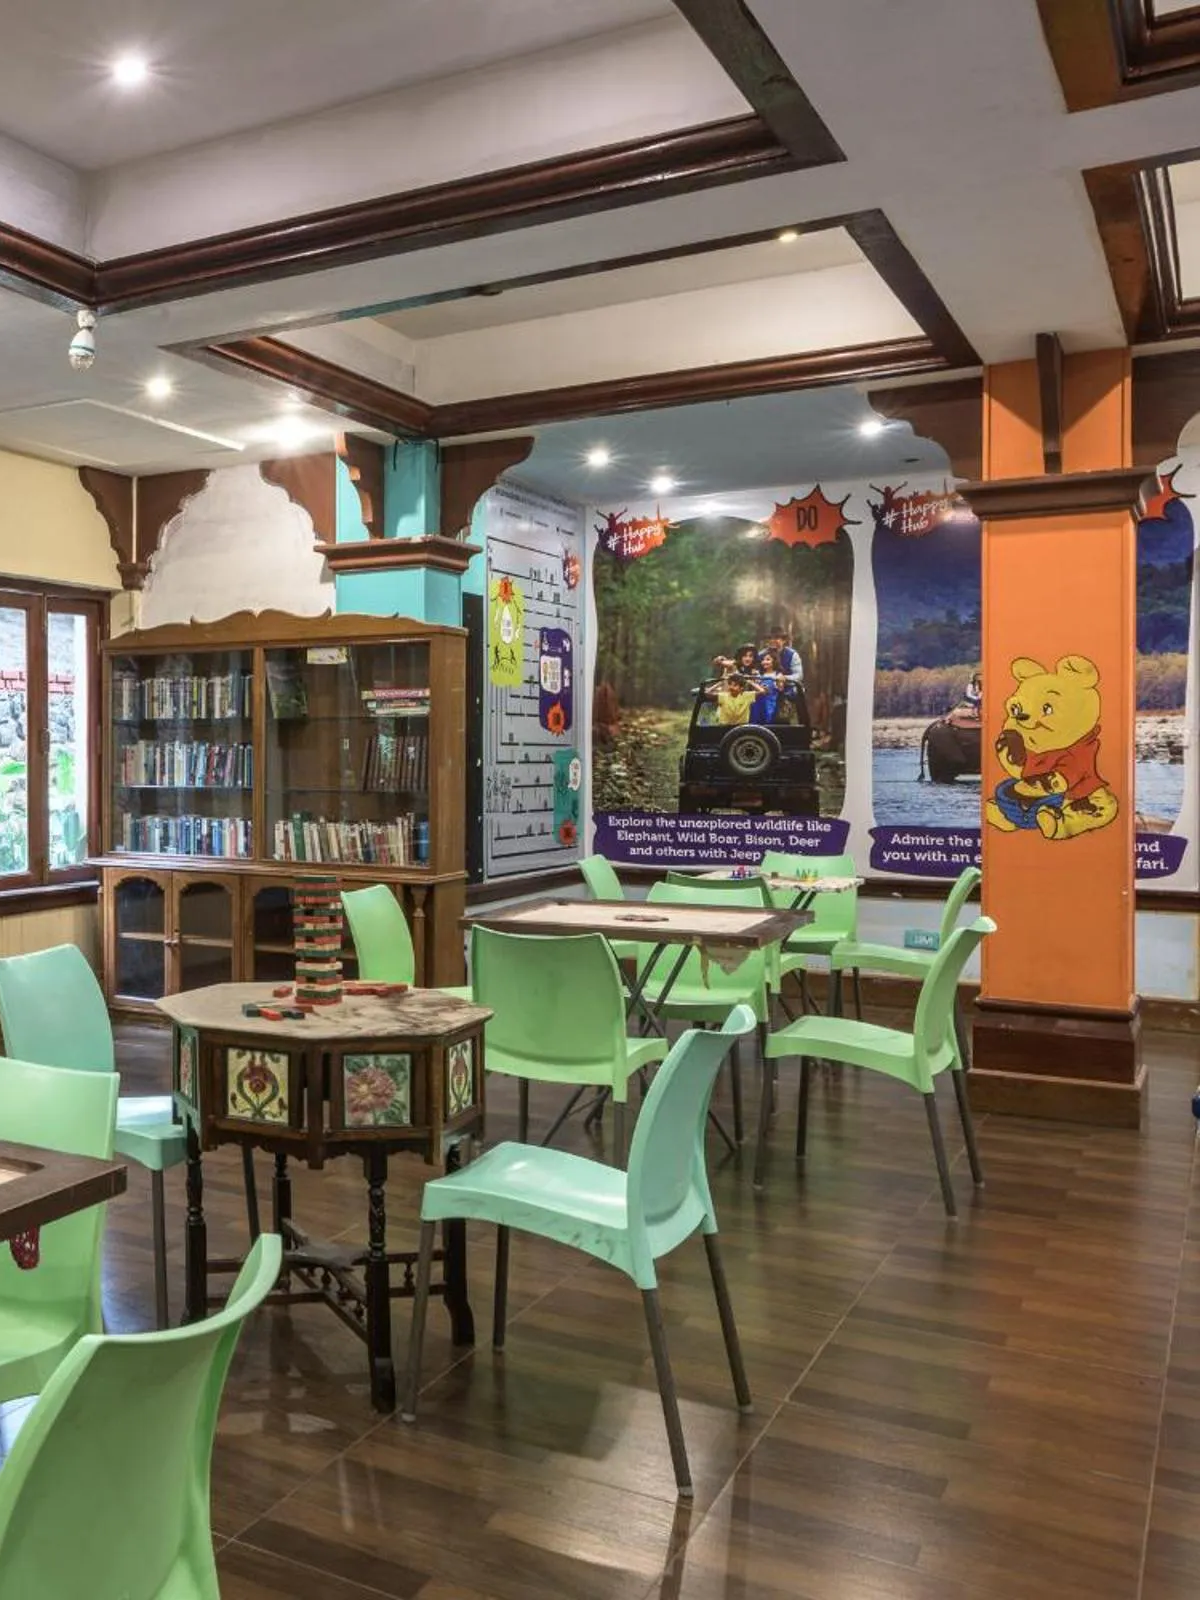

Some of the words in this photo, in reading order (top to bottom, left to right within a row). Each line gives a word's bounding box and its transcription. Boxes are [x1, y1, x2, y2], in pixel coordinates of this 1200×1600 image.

[902, 499, 952, 518] Happy
[796, 507, 818, 532] DO
[902, 517, 929, 533] Hub
[623, 524, 662, 542] Happy
[623, 539, 646, 556] Hub
[608, 815, 653, 828] Explore
[656, 817, 676, 828] the
[680, 818, 751, 831] unexplored
[755, 819, 803, 831] wildlife
[807, 820, 831, 832] like
[617, 830, 674, 842] Elephant,
[677, 831, 705, 843] Wild
[709, 832, 741, 845] Boar,
[745, 834, 785, 846] Bison,
[790, 835, 821, 847] Deer
[891, 833, 945, 846] Admire
[949, 835, 973, 847] the
[630, 845, 652, 856] and
[655, 846, 695, 858] others
[698, 847, 727, 859] with
[731, 849, 761, 861] Jeep
[883, 851, 911, 862] you
[914, 850, 947, 862] with
[951, 853, 970, 863] an
[1136, 857, 1169, 870] fari.
